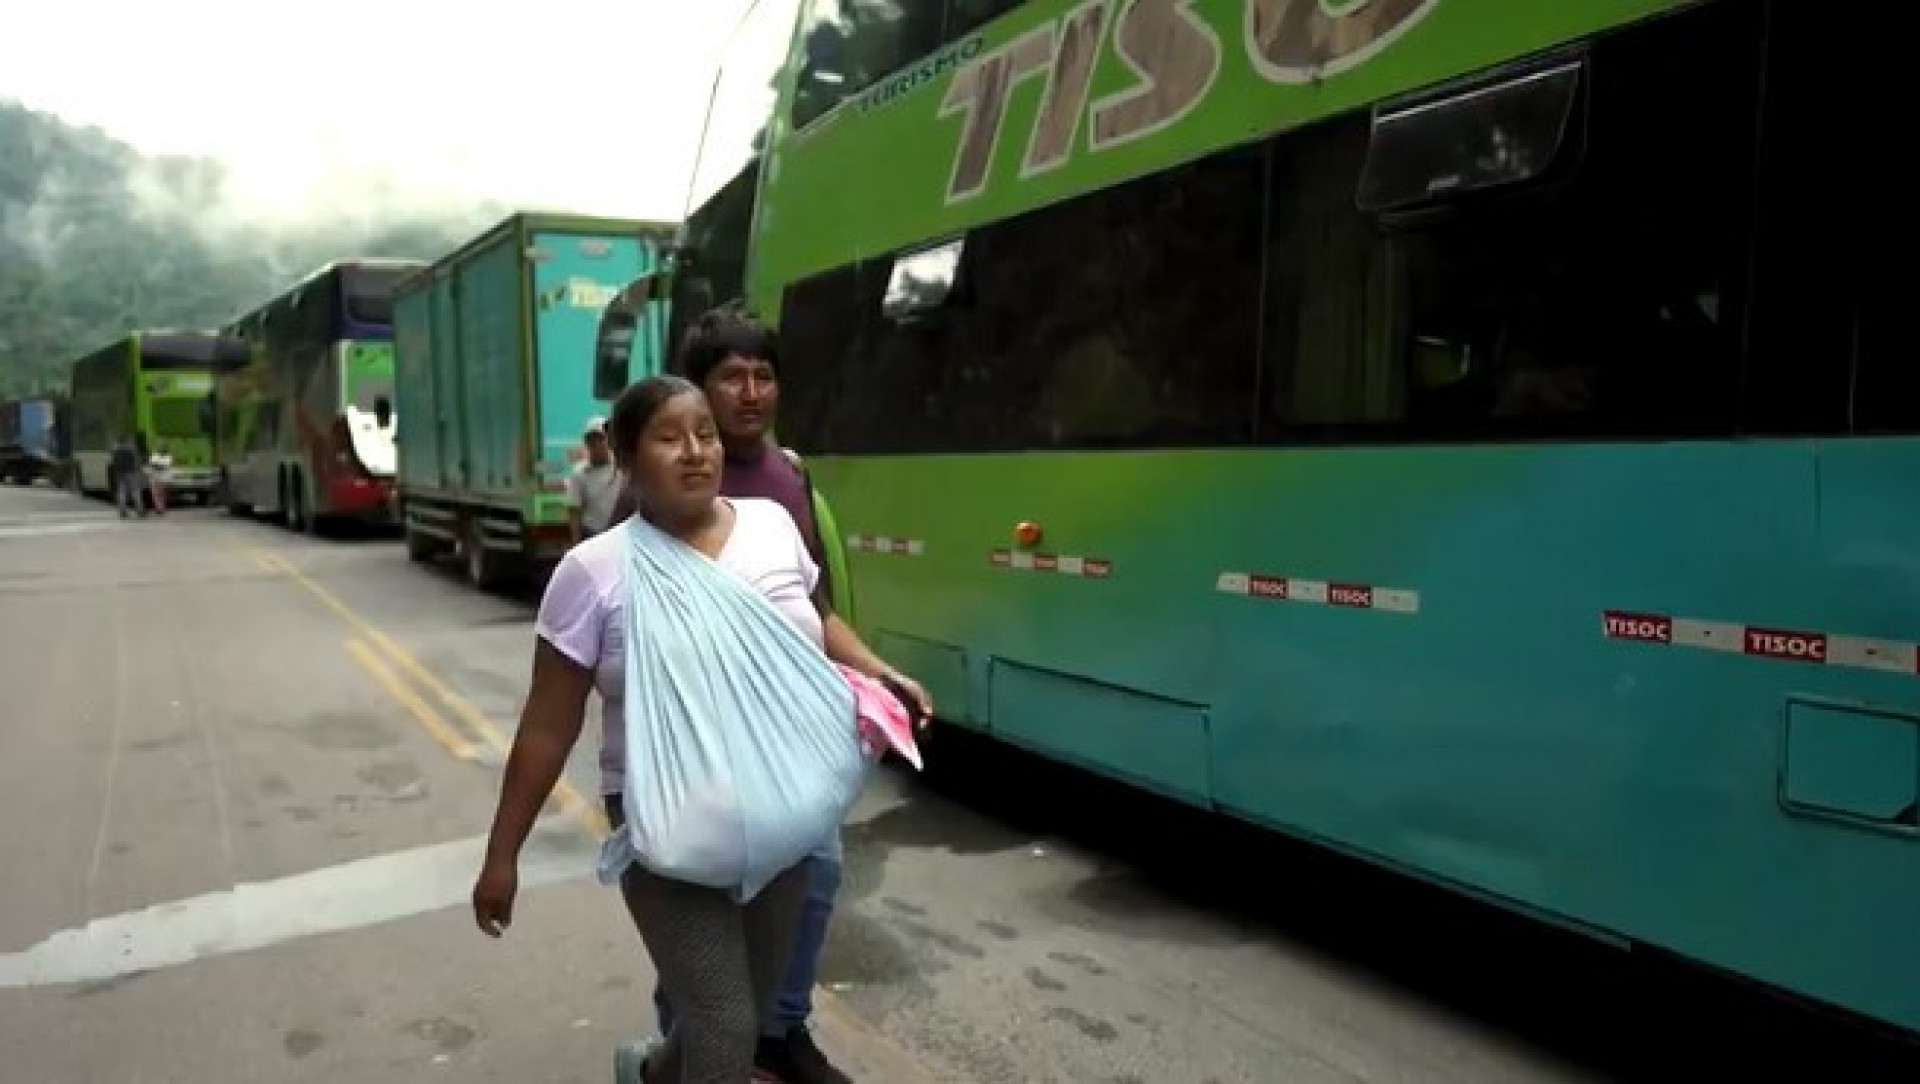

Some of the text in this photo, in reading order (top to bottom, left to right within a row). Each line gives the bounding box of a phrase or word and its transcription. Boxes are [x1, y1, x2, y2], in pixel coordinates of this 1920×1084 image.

[858, 37, 984, 112] TURISMO
[1606, 618, 1670, 639] TISOC
[1750, 633, 1824, 658] TISOC
